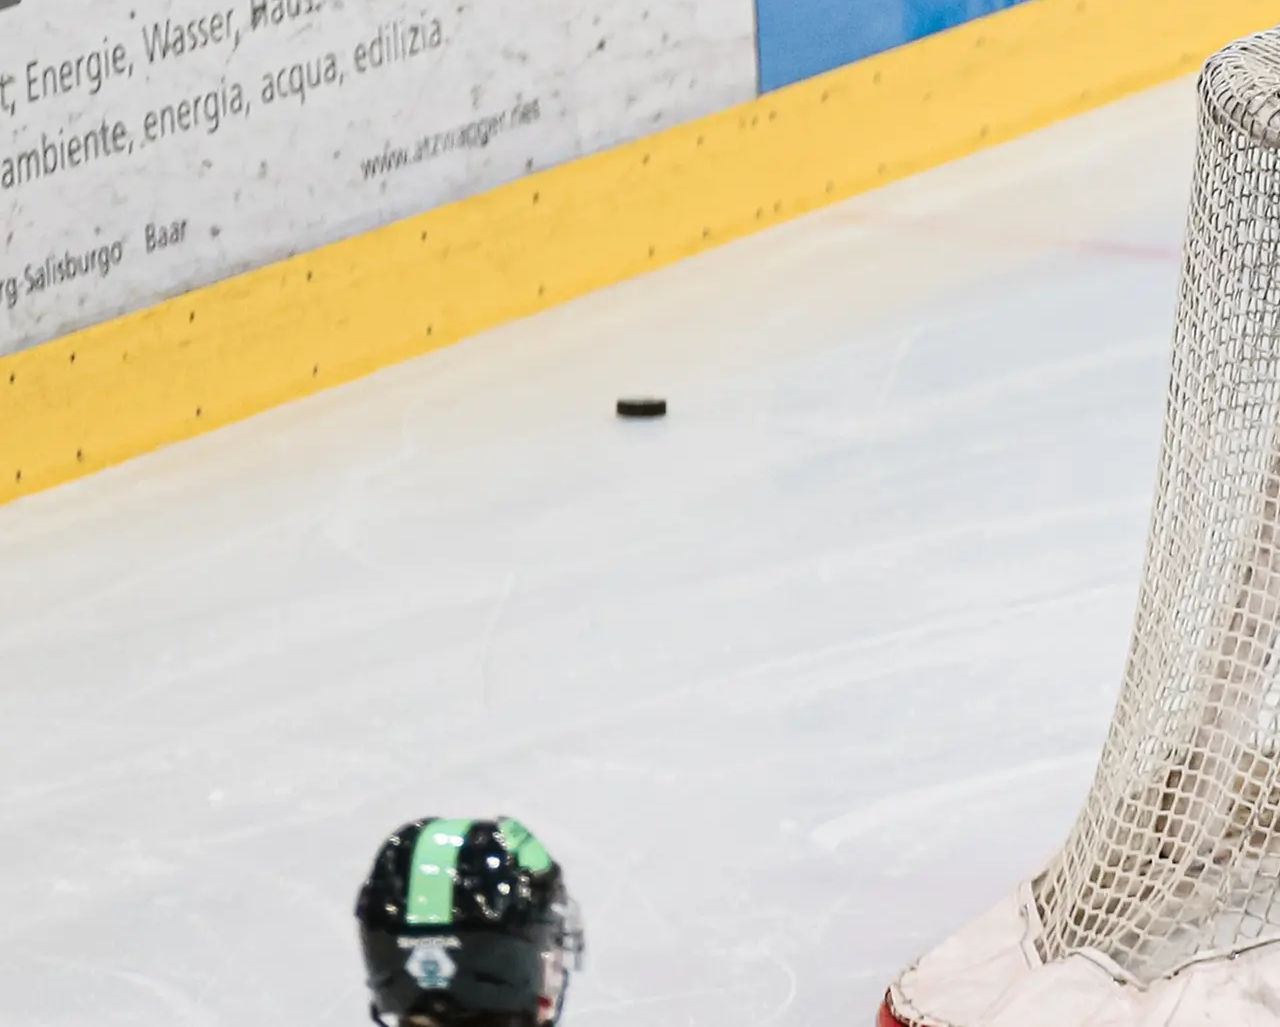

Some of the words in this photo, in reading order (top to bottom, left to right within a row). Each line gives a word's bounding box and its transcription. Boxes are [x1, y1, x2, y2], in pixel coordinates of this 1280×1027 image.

[26, 37, 134, 104] Energie,
[142, 8, 241, 64] Wasser,
[0, 118, 135, 190] ambiente,
[143, 76, 251, 143] energia,
[260, 52, 345, 105] acqua,
[144, 219, 188, 254] Baar
